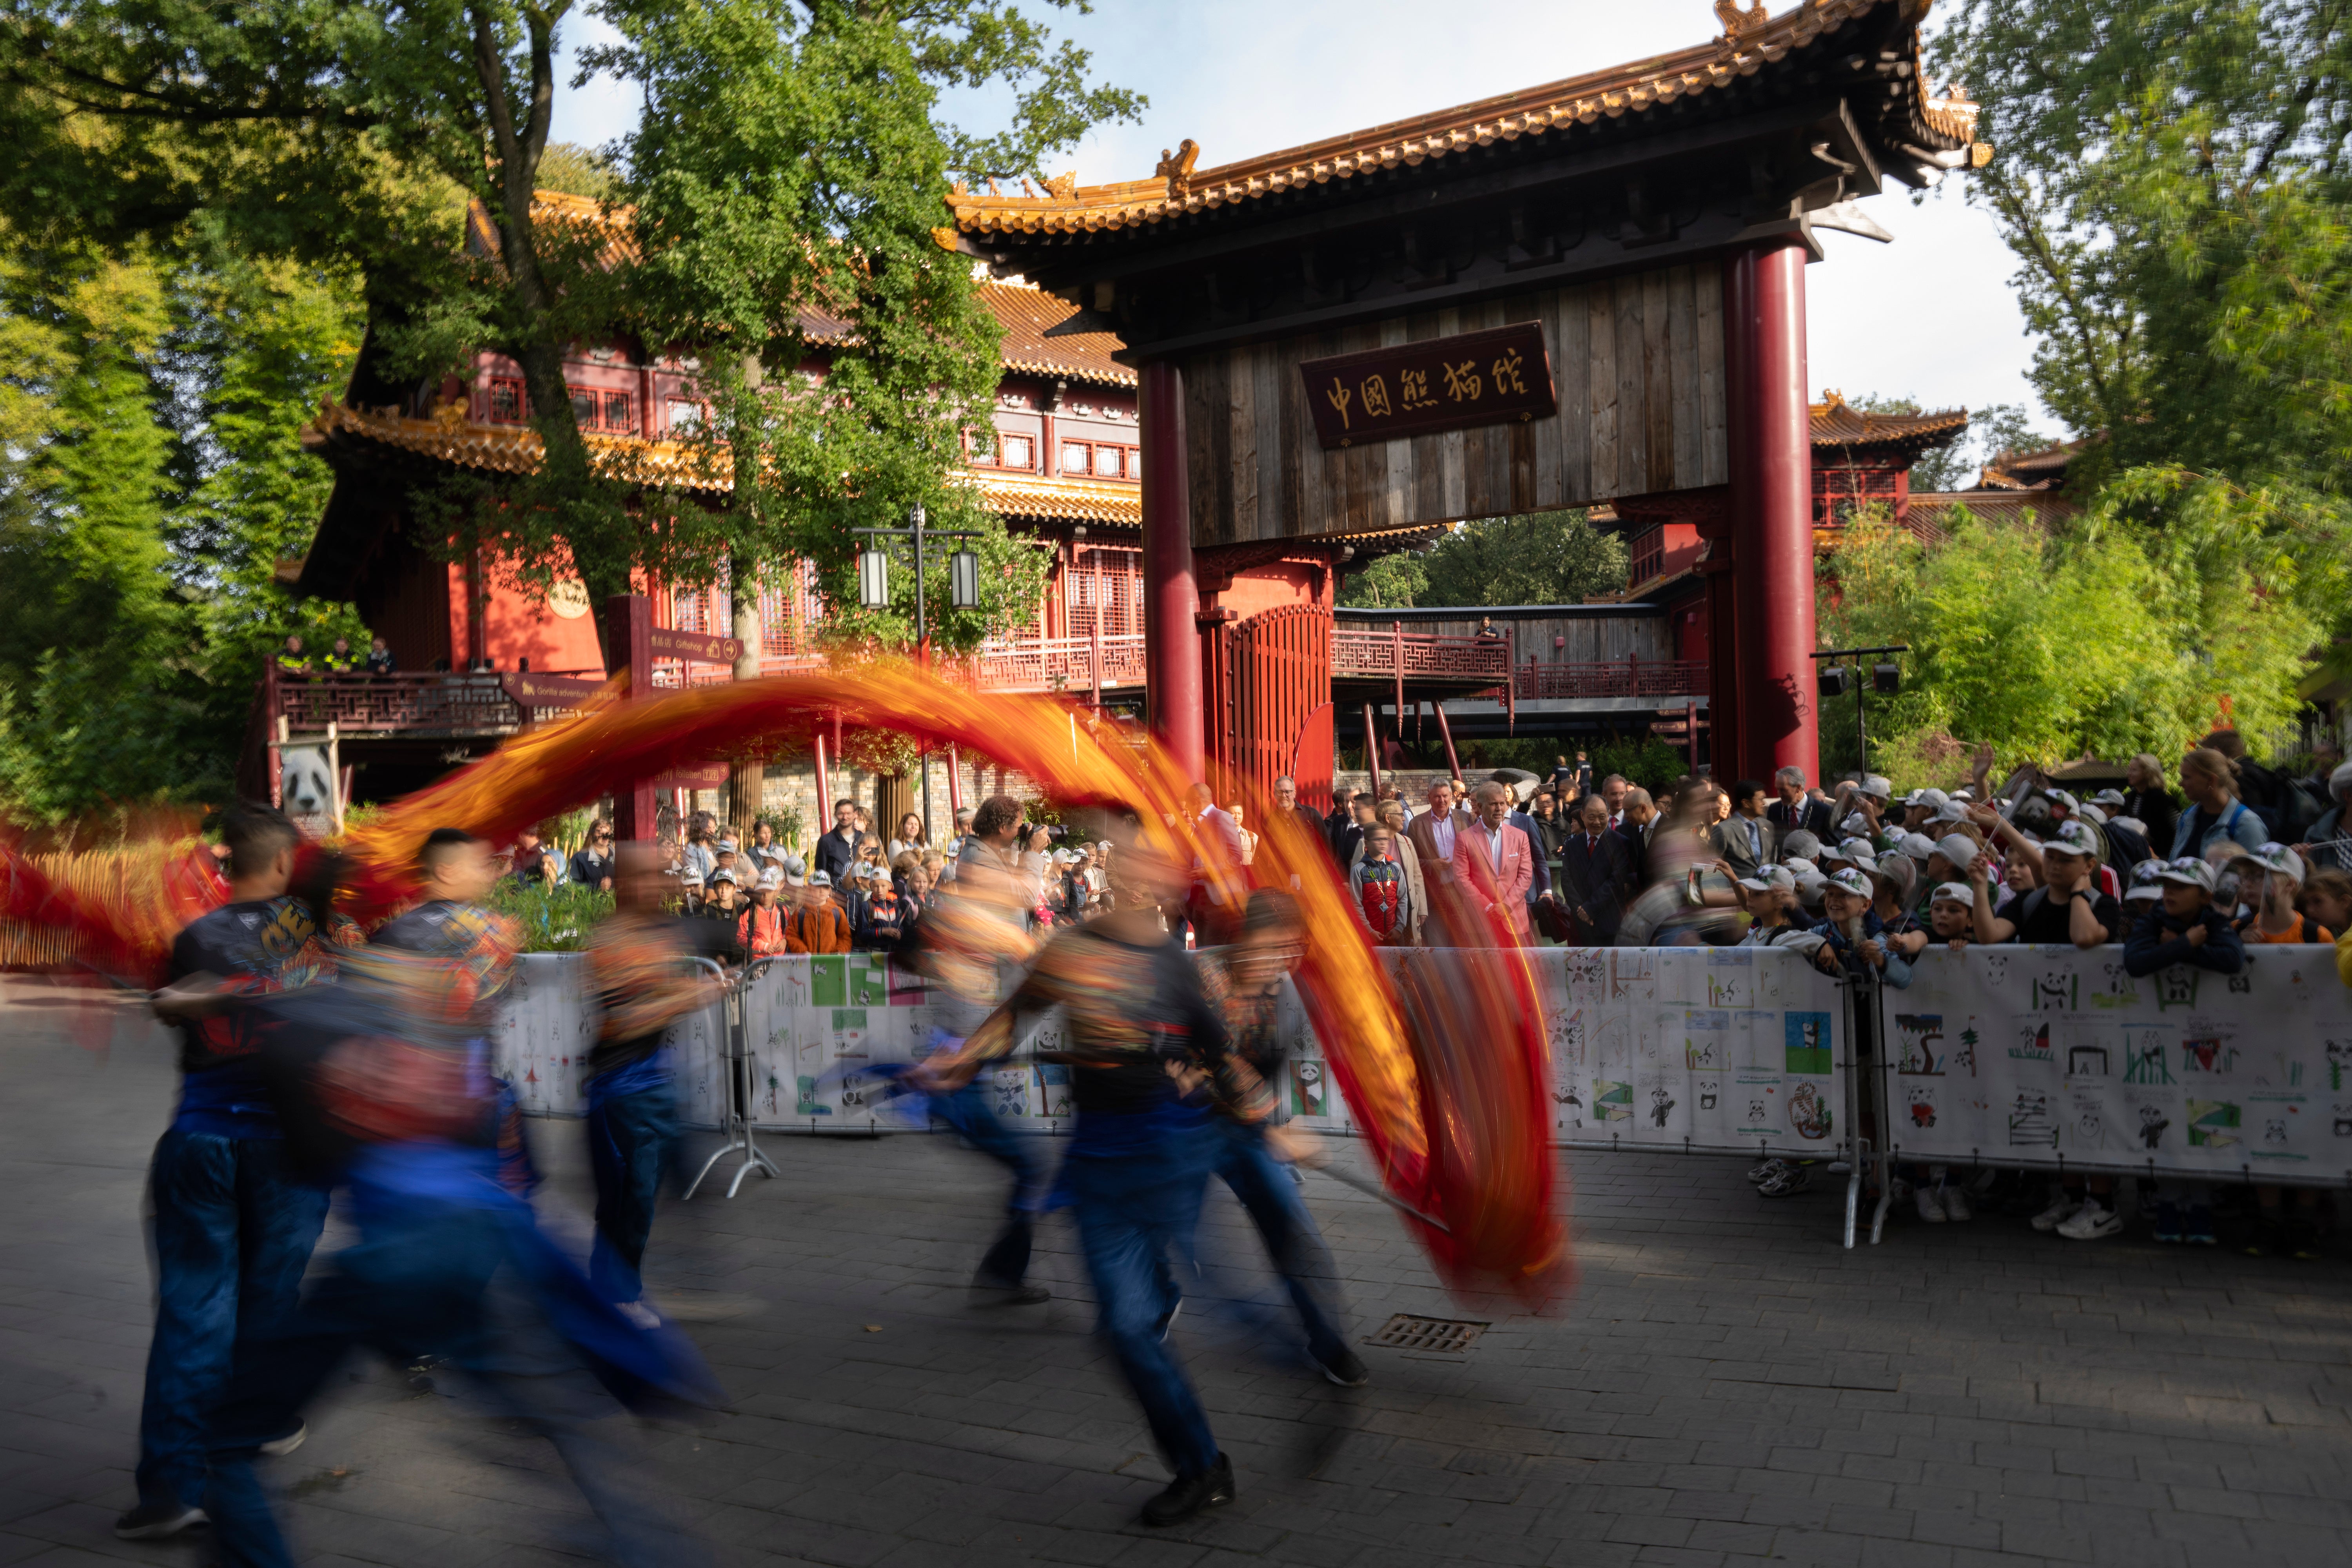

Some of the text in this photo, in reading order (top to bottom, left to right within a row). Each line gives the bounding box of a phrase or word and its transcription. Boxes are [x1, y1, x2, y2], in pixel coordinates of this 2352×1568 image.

[676, 639, 702, 653] Giftshop
[537, 686, 557, 696] Gorilla
[559, 689, 588, 699] adventure
[675, 769, 701, 779] Toiletten
